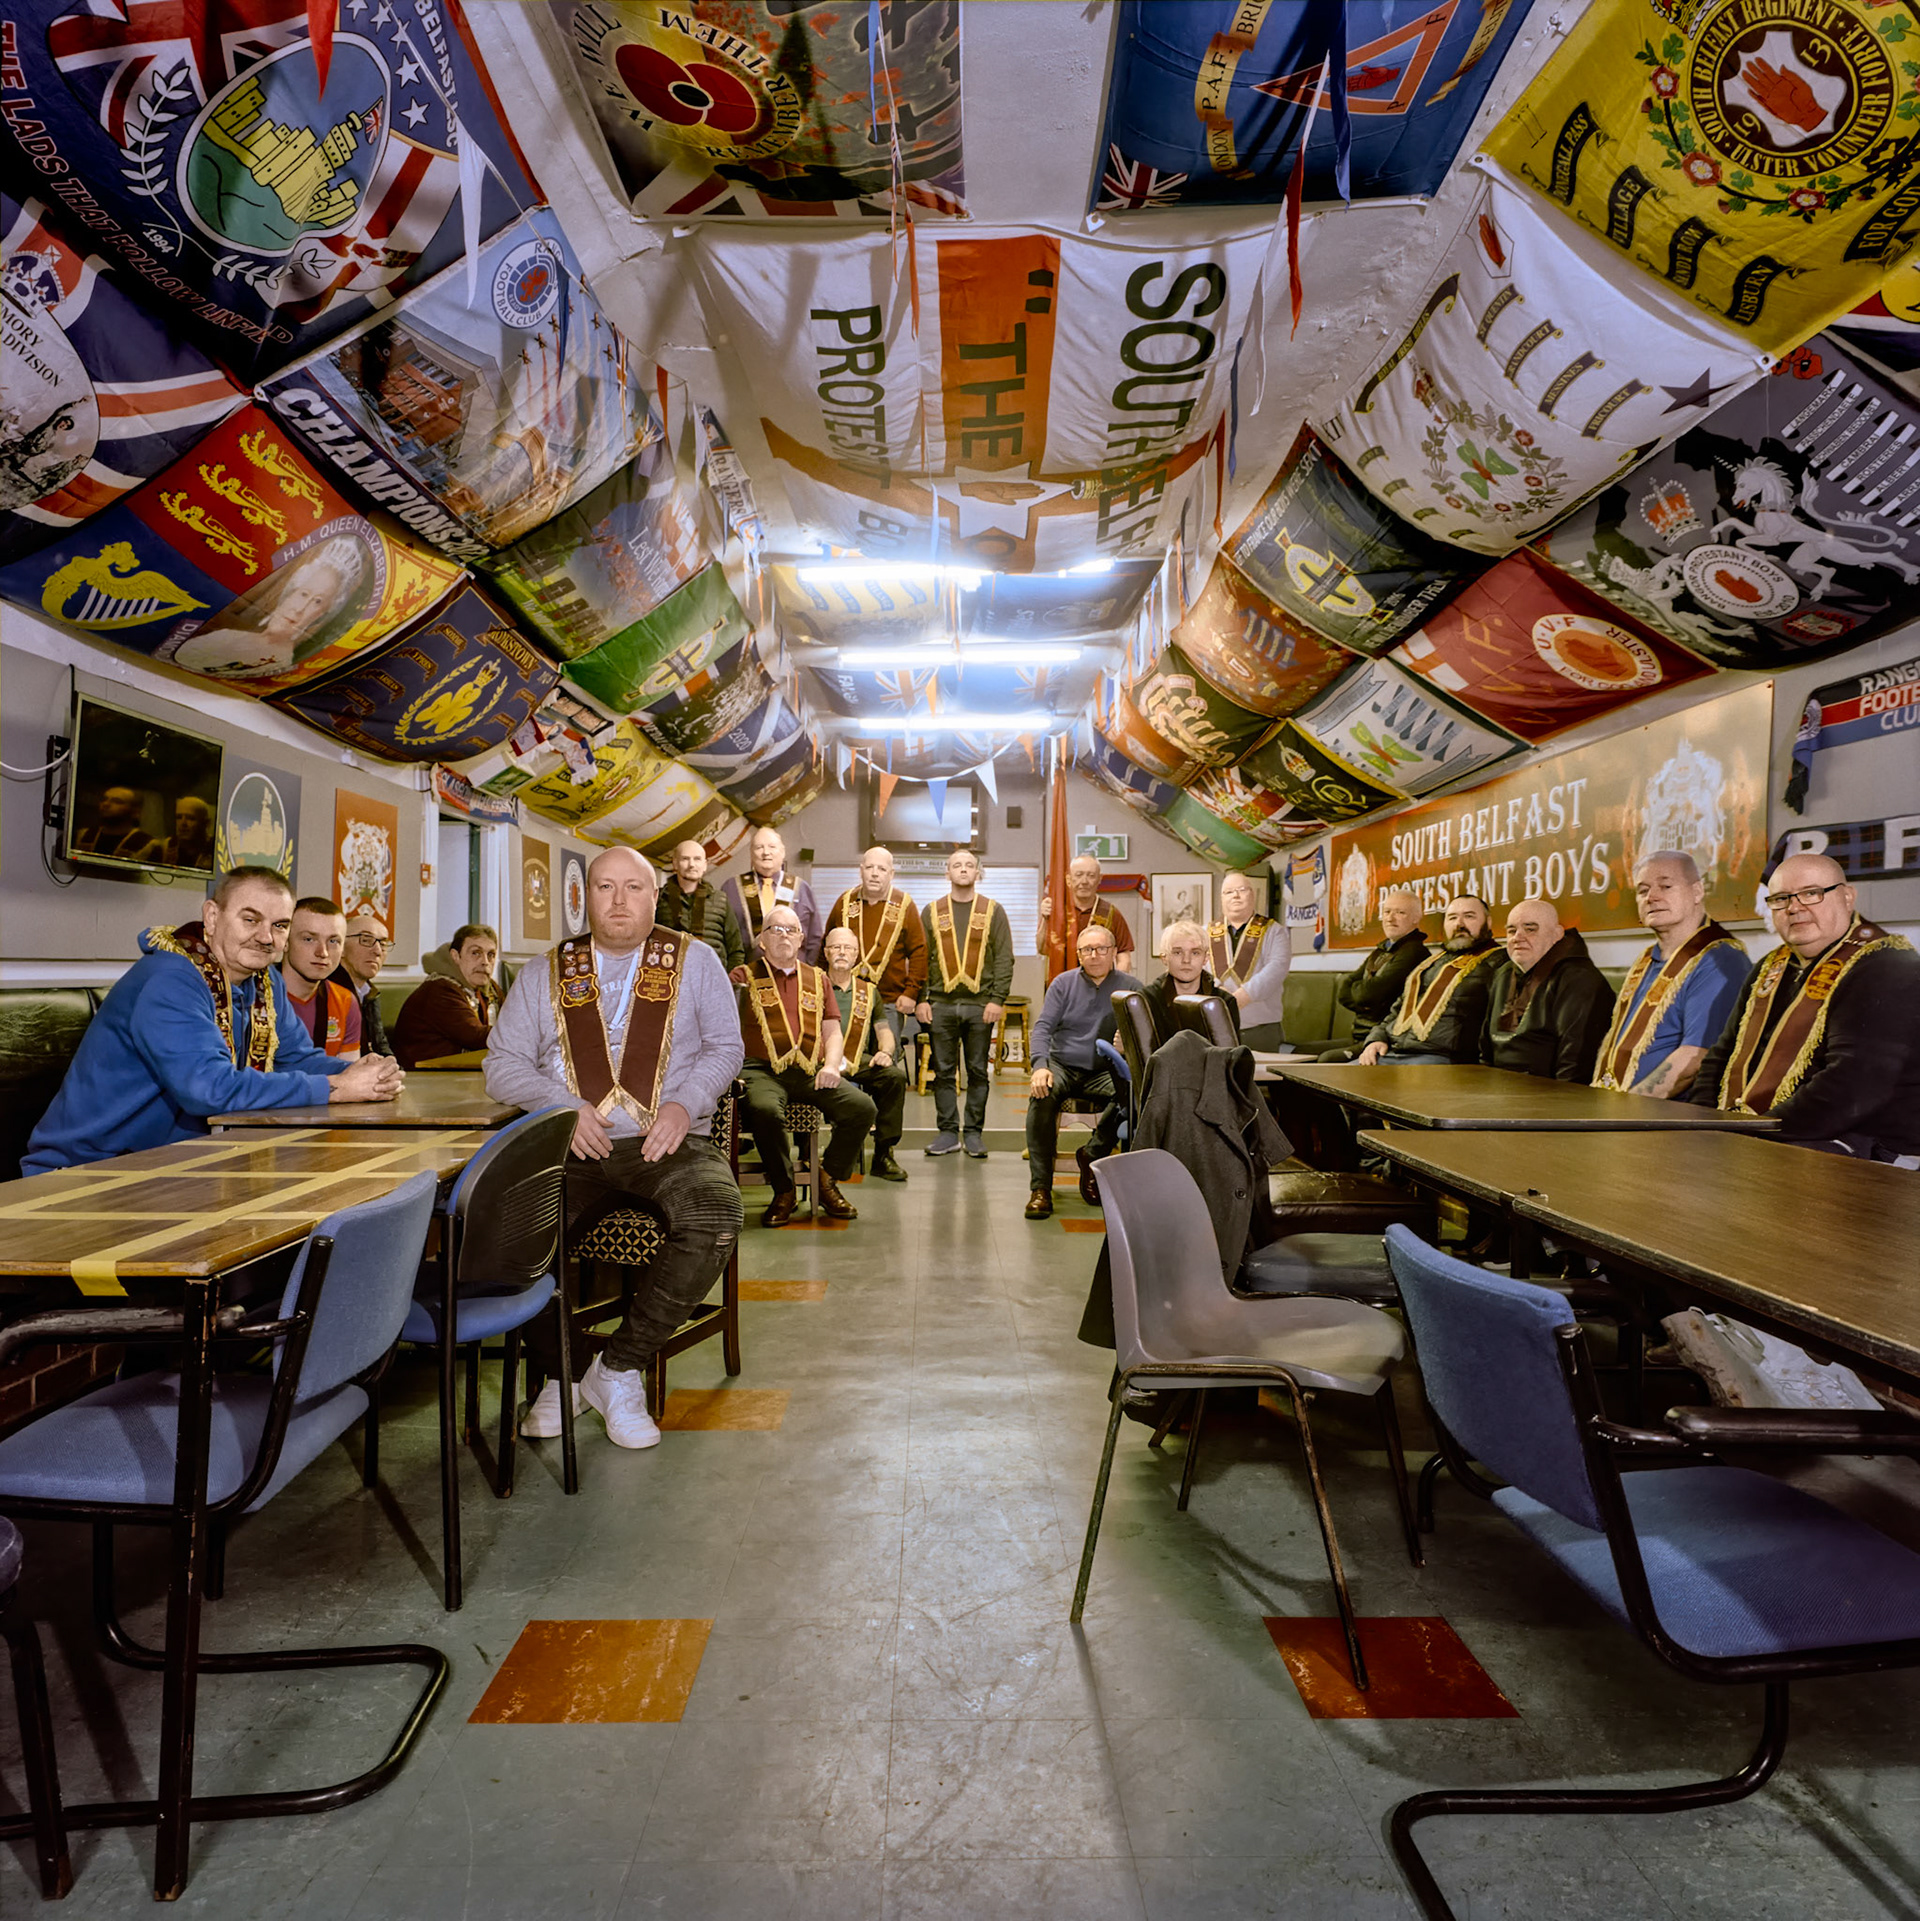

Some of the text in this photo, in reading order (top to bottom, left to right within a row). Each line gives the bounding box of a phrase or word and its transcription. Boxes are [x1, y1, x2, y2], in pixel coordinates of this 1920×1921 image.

[0, 21, 28, 90] THE
[413, 0, 458, 99] BELFAST
[1799, 37, 1832, 68] 13
[573, 3, 802, 160] WE WILL REMEMBER THEM
[1693, 0, 1844, 144] SOUTH BELFAST REGIMENT
[1729, 22, 1891, 178] ULSTER VOLUNTEER FORCE
[0, 98, 70, 176] LADS
[1564, 112, 1590, 148] PASS
[1732, 111, 1763, 139] 19
[50, 177, 122, 233] THAT
[1611, 177, 1642, 244] VILLAGE
[141, 227, 177, 255] 1994
[1676, 227, 1704, 254] ROW
[1857, 221, 1898, 252] FOR
[101, 232, 207, 304] FOLLOW
[496, 262, 543, 326] FOOTBALL CLUB
[1484, 289, 1514, 324] QUENTIN
[1734, 264, 1775, 323] LISBURN
[2, 333, 65, 388] DIVISION
[1101, 260, 1228, 465] SOUTH
[1544, 363, 1584, 403] MESSINES
[1588, 388, 1631, 431] FRICOURT
[1789, 384, 1838, 430] LANGEMARK
[1847, 400, 1879, 437] REDOUBT
[272, 387, 467, 547] CHAMPIONS
[1840, 433, 1880, 469] CAMBRAI
[714, 453, 749, 516] RANGERS
[1244, 521, 1270, 552] FRANCE
[1296, 439, 1323, 476] SENT
[1875, 462, 1912, 493] ALBERT
[299, 535, 317, 552] M.
[319, 516, 359, 539] QUEEN
[359, 520, 386, 598] ELIZABETH
[627, 525, 656, 566] Lest
[1690, 548, 1748, 576] PROTESTANT
[1750, 558, 1785, 584] BOYS
[1420, 578, 1452, 603] THEM
[442, 627, 466, 647] SOMME
[1605, 626, 1657, 671] ULSTER
[412, 651, 433, 670] YPRES
[1859, 663, 1920, 696] RANG
[728, 727, 754, 752] 2020
[1880, 704, 1920, 731] CLU
[1390, 777, 1588, 872] SOUTH BELFAST
